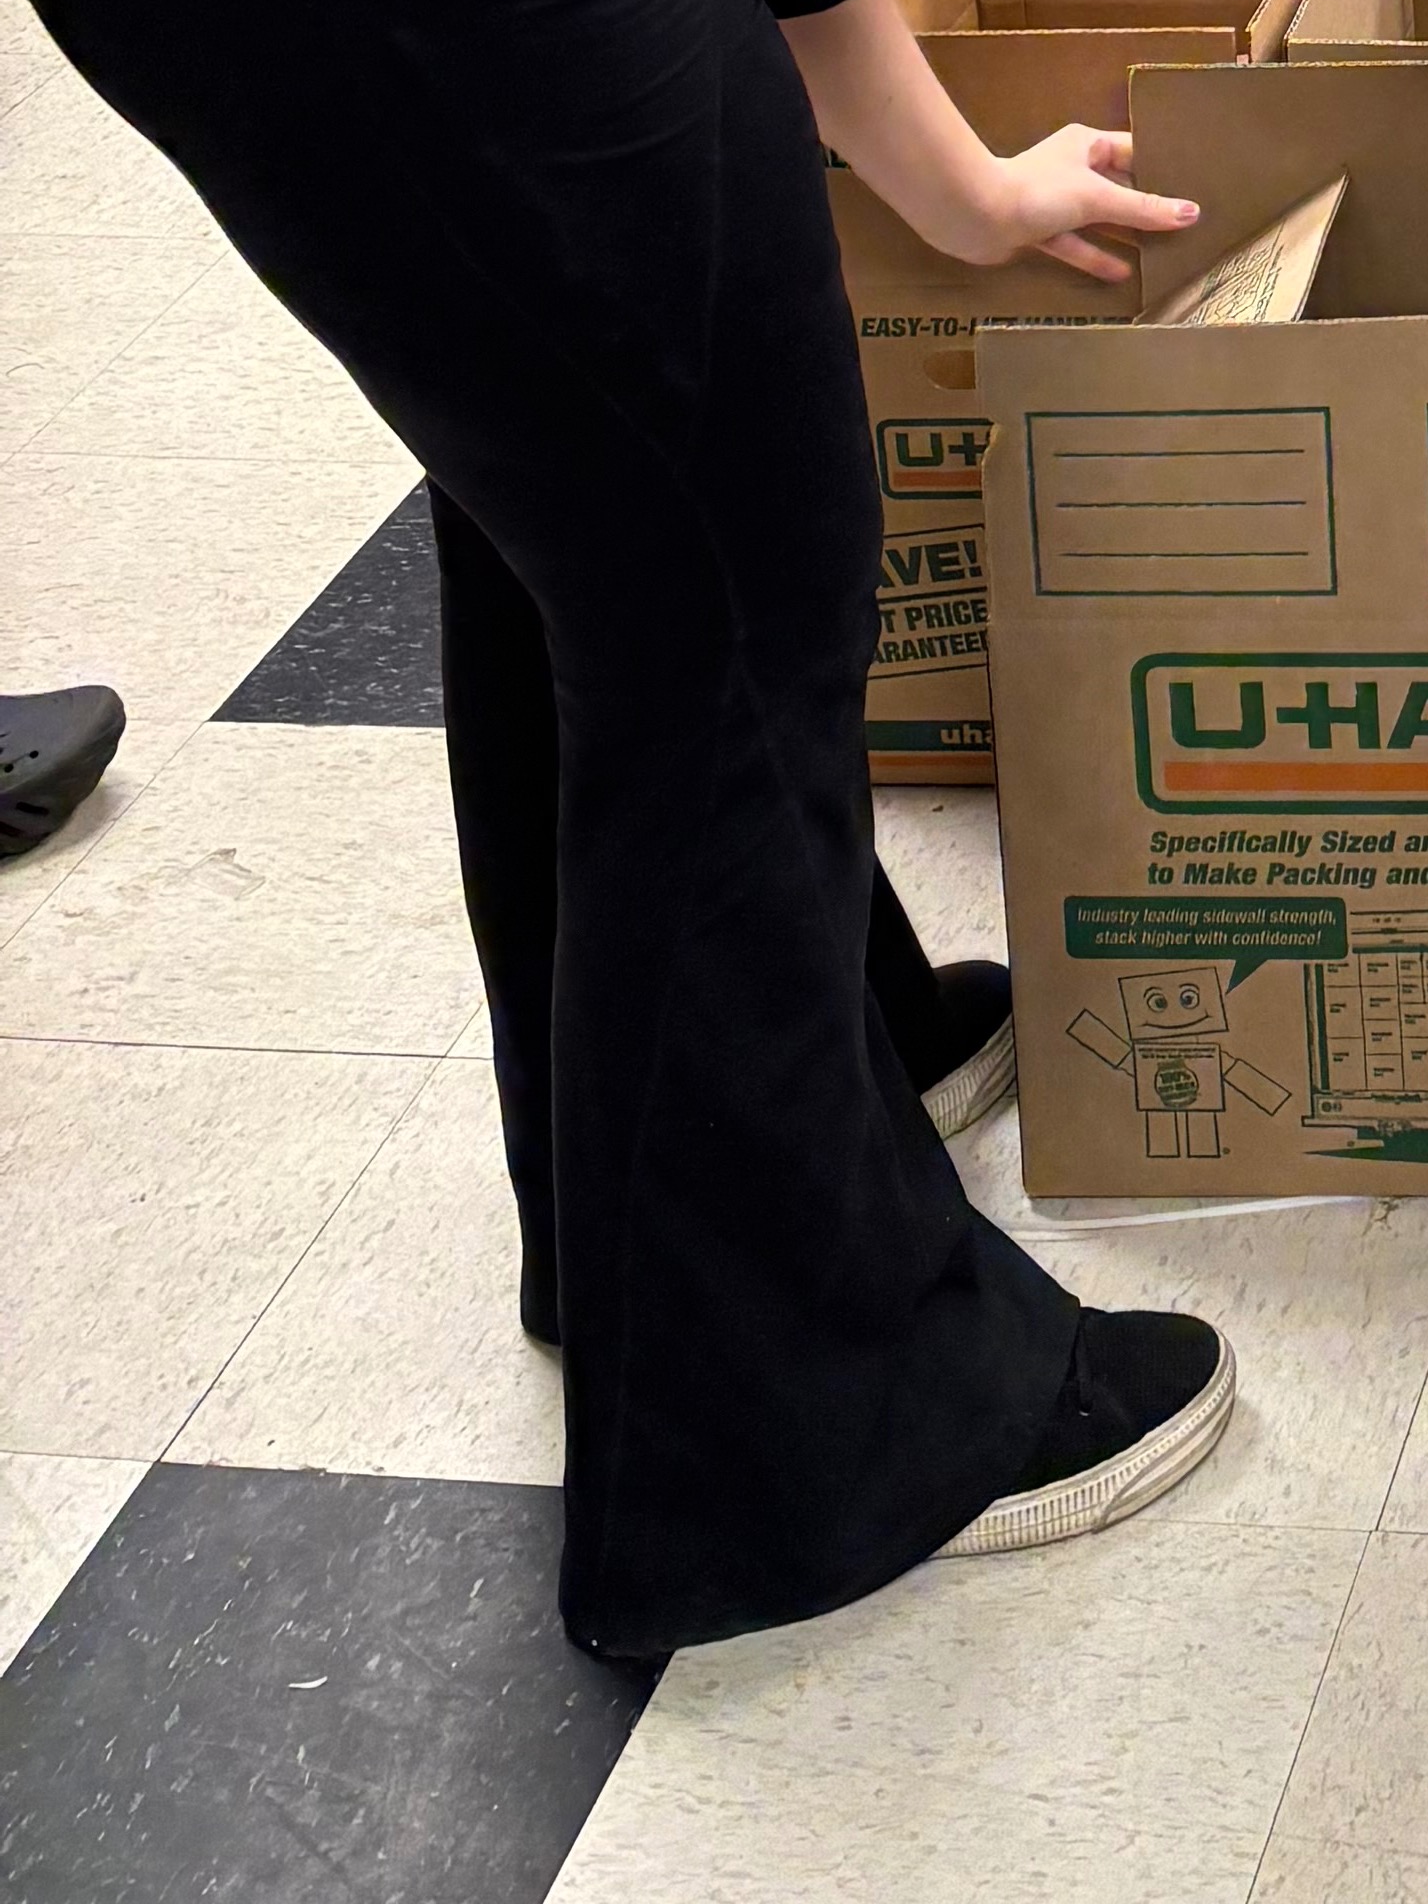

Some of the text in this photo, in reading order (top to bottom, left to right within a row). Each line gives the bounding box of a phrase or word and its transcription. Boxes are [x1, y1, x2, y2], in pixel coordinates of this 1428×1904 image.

[904, 598, 988, 632] PRICE
[1149, 830, 1312, 856] Specifically
[1320, 830, 1397, 853] Sized
[1147, 863, 1174, 886] to
[1182, 863, 1256, 886] Make
[1266, 863, 1376, 889] Packing
[1077, 906, 1337, 927] Industry leading sidewall strength,
[1095, 930, 1322, 948] stack higher with confidence!
